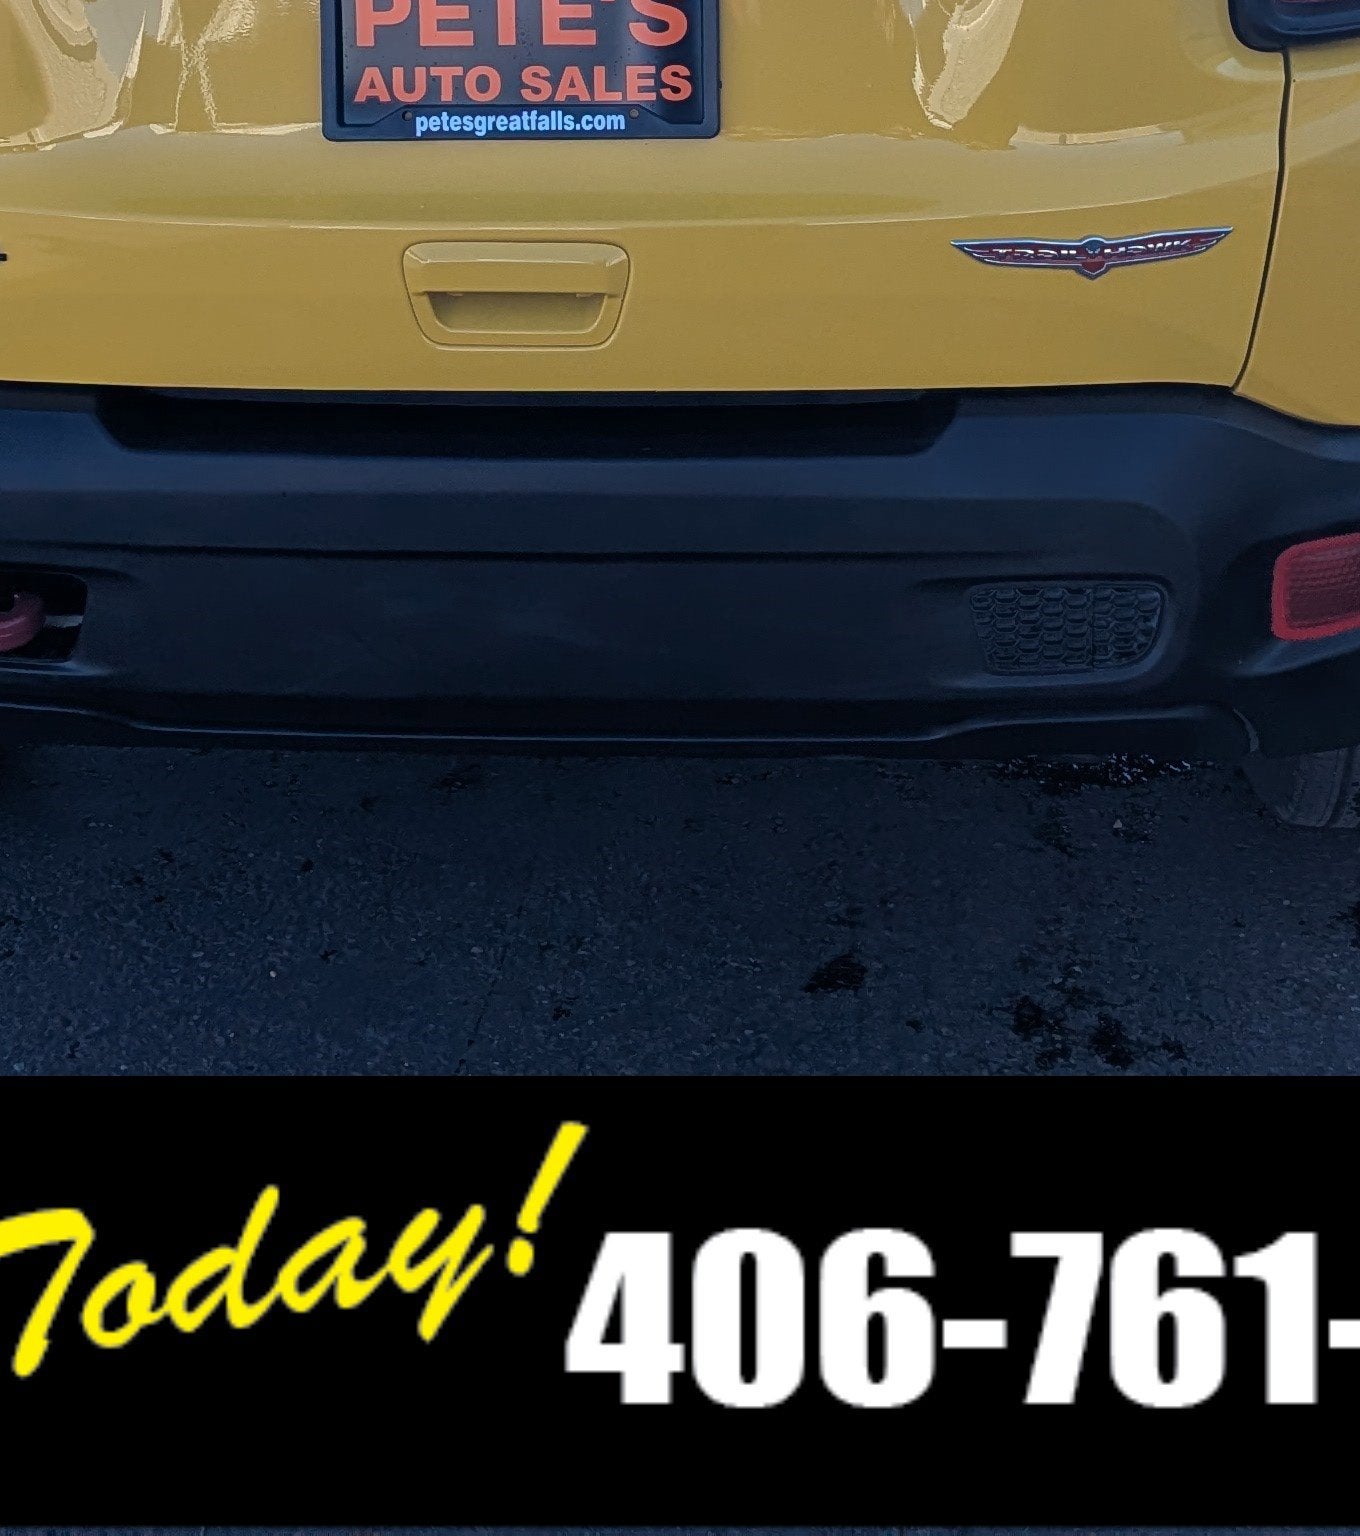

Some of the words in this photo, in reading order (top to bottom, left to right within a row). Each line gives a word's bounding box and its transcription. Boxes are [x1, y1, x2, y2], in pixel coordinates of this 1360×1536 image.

[354, 65, 502, 104] AUTO
[520, 64, 694, 103] SALES
[415, 109, 626, 137] petesgreatfalls.com
